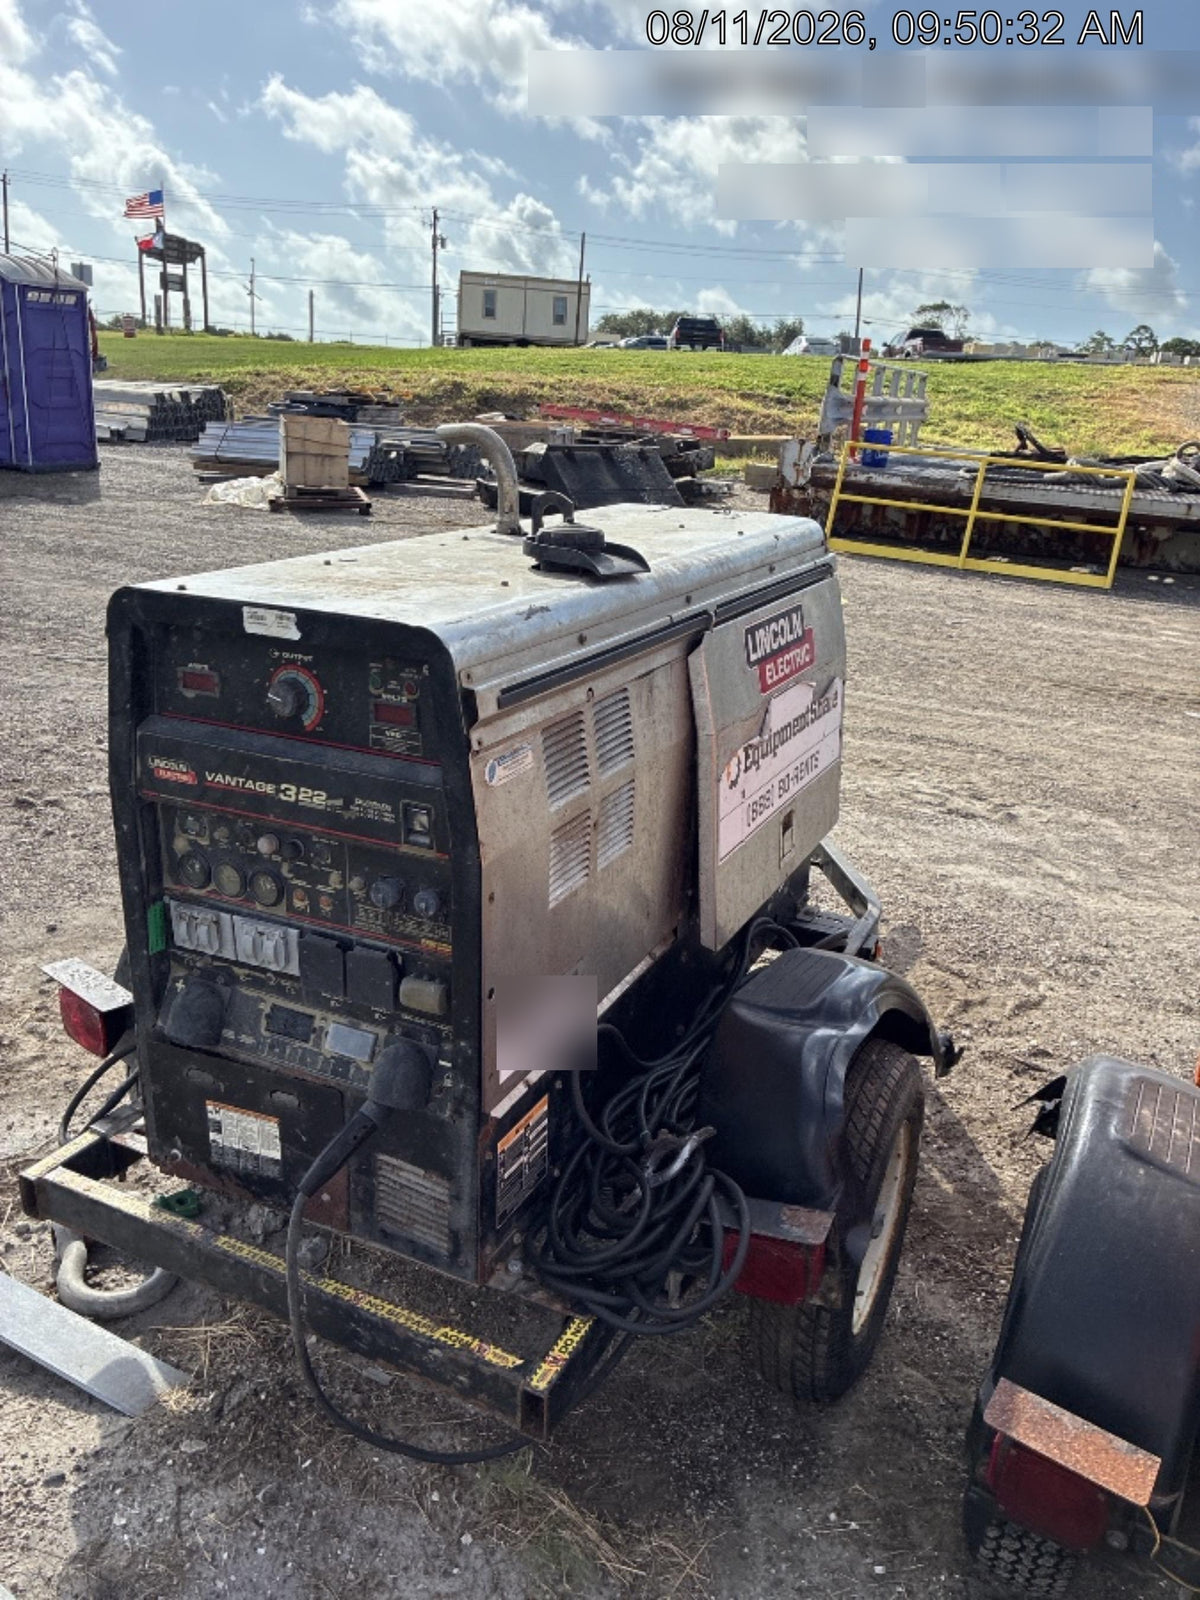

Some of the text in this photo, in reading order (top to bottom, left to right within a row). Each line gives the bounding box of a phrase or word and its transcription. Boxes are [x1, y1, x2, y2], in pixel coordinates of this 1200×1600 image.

[747, 610, 803, 661] LINCOLN
[765, 642, 811, 686] ELECTRIC
[205, 771, 327, 805] VANTAGE 322
